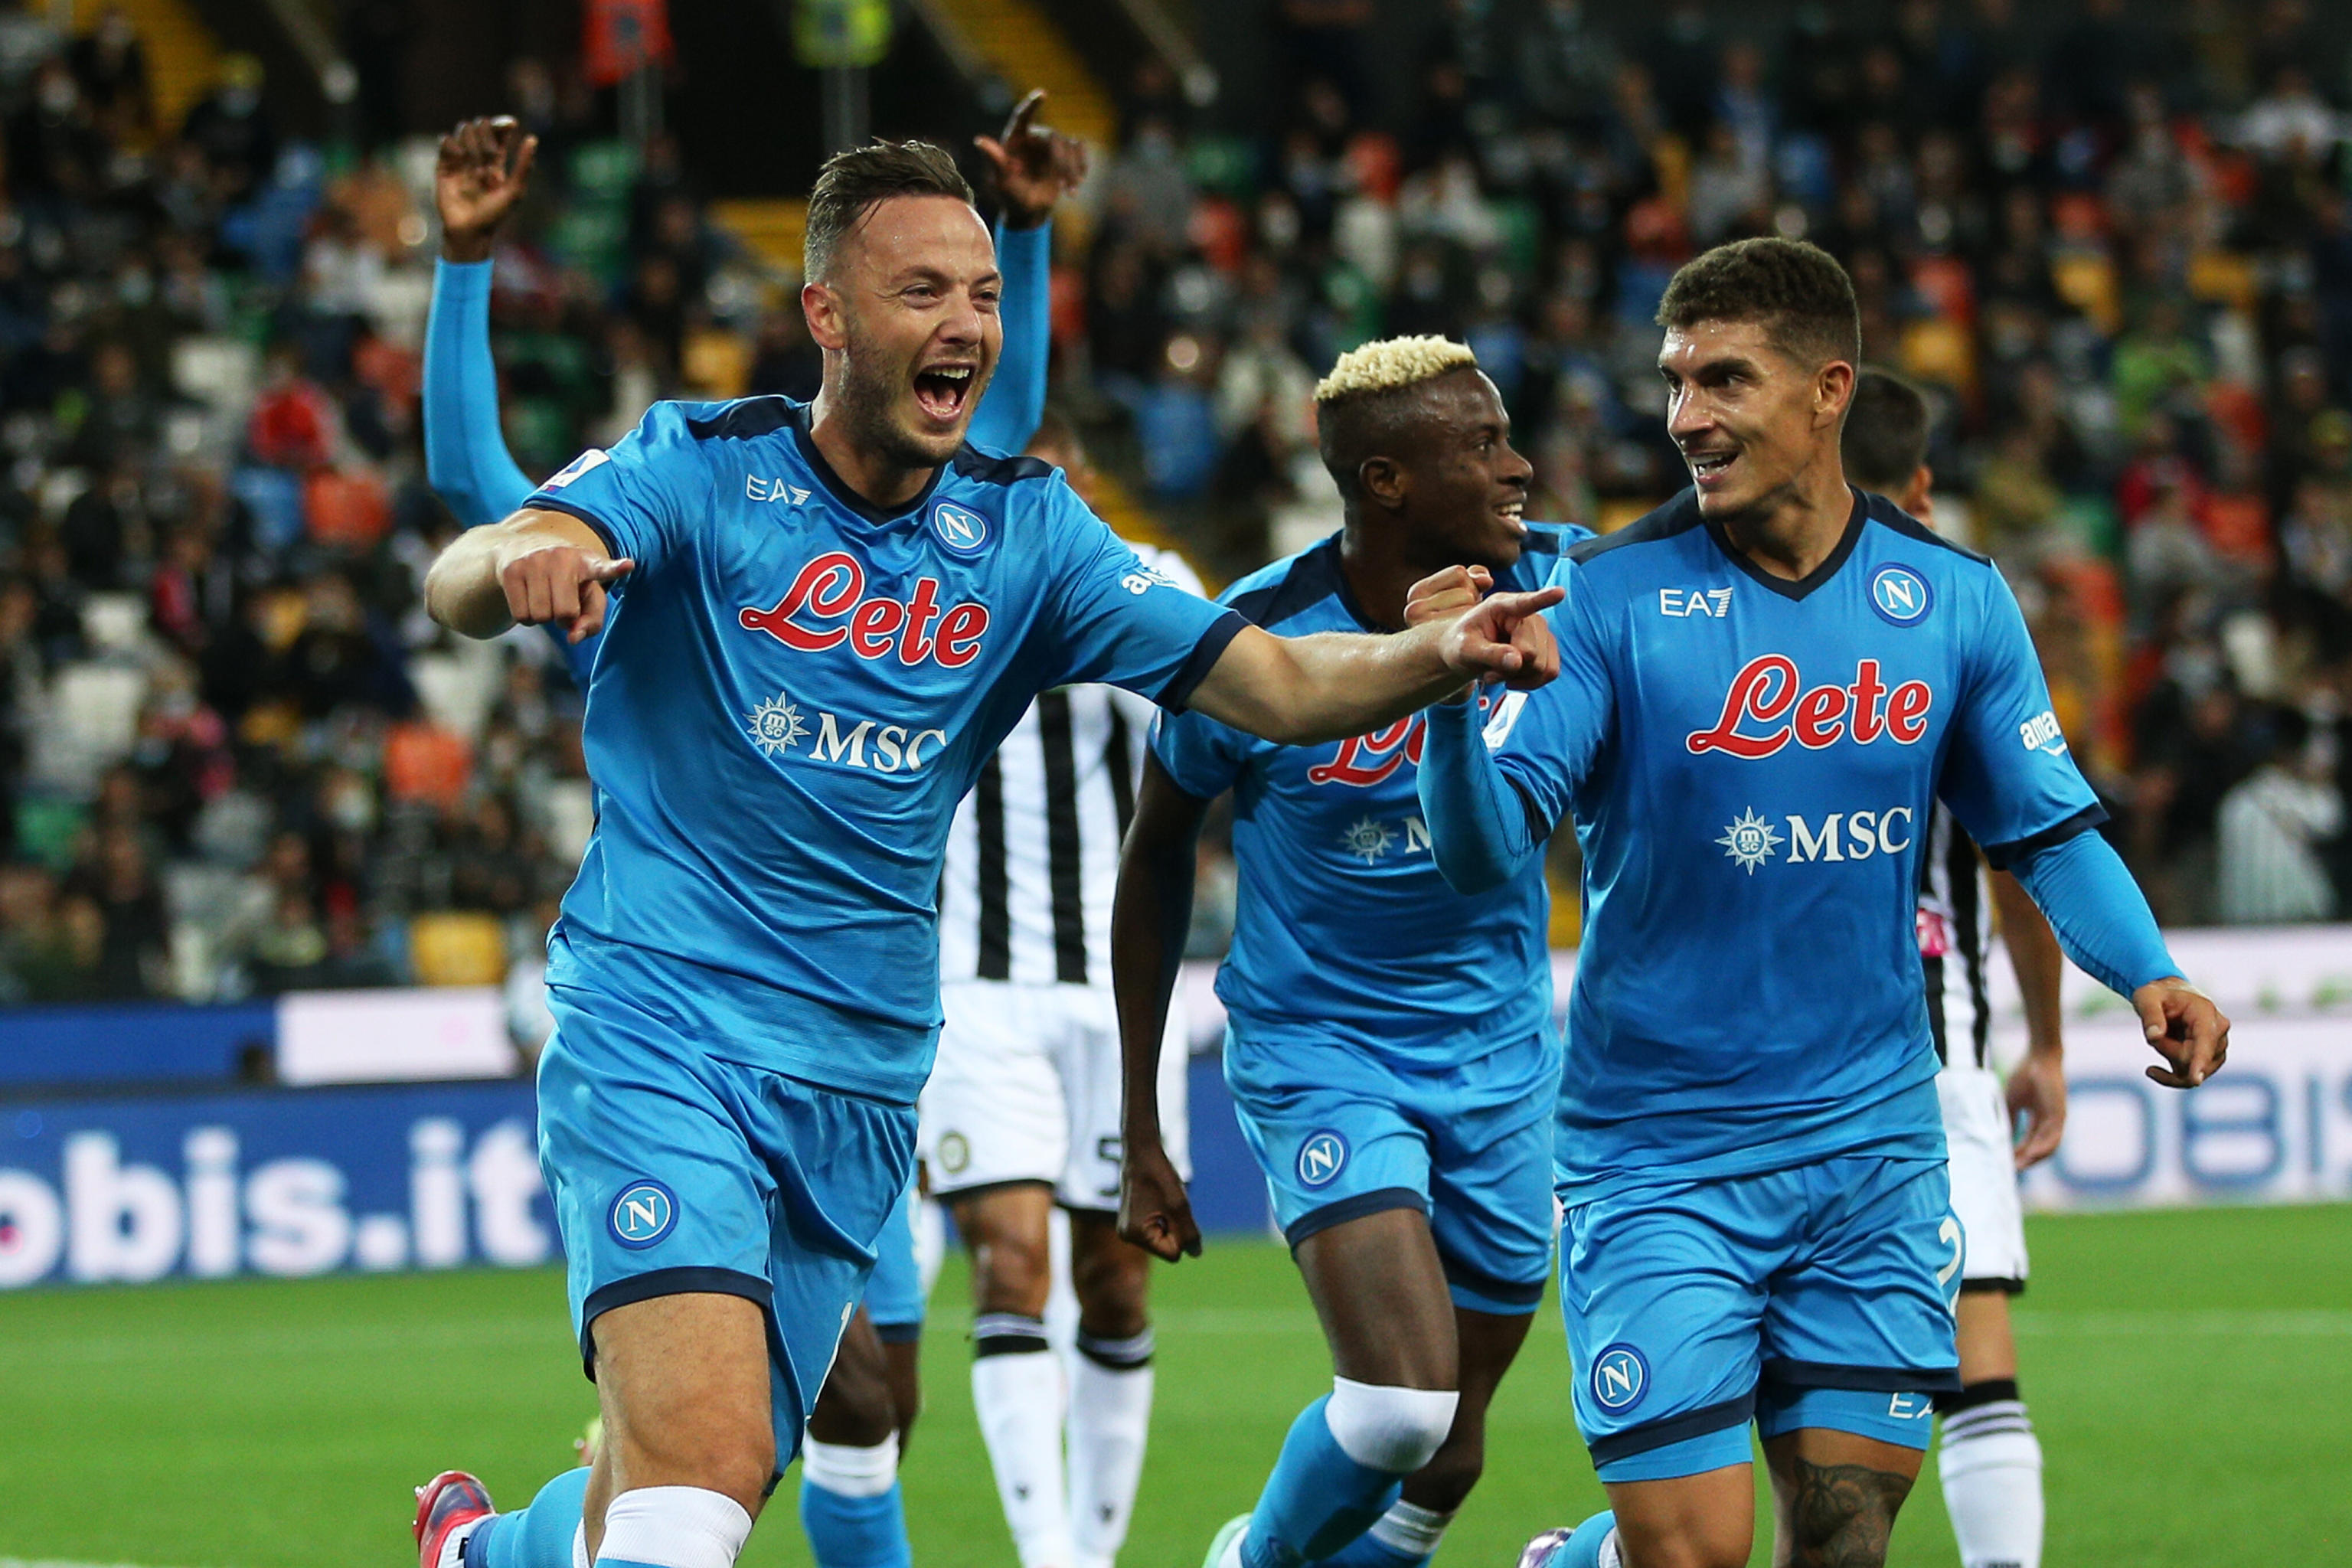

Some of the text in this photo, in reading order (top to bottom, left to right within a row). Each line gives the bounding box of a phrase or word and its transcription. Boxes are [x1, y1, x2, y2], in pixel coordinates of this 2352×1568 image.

[941, 511, 974, 541] N
[739, 550, 990, 668] Lete
[1660, 587, 1733, 618] EA7
[1883, 580, 1915, 610] N
[1686, 653, 1932, 760] Lete
[808, 712, 947, 773] MSC
[1785, 807, 1913, 864] MSC
[1307, 1141, 1333, 1179] N
[625, 1195, 658, 1232] N
[1602, 1358, 1631, 1399] N
